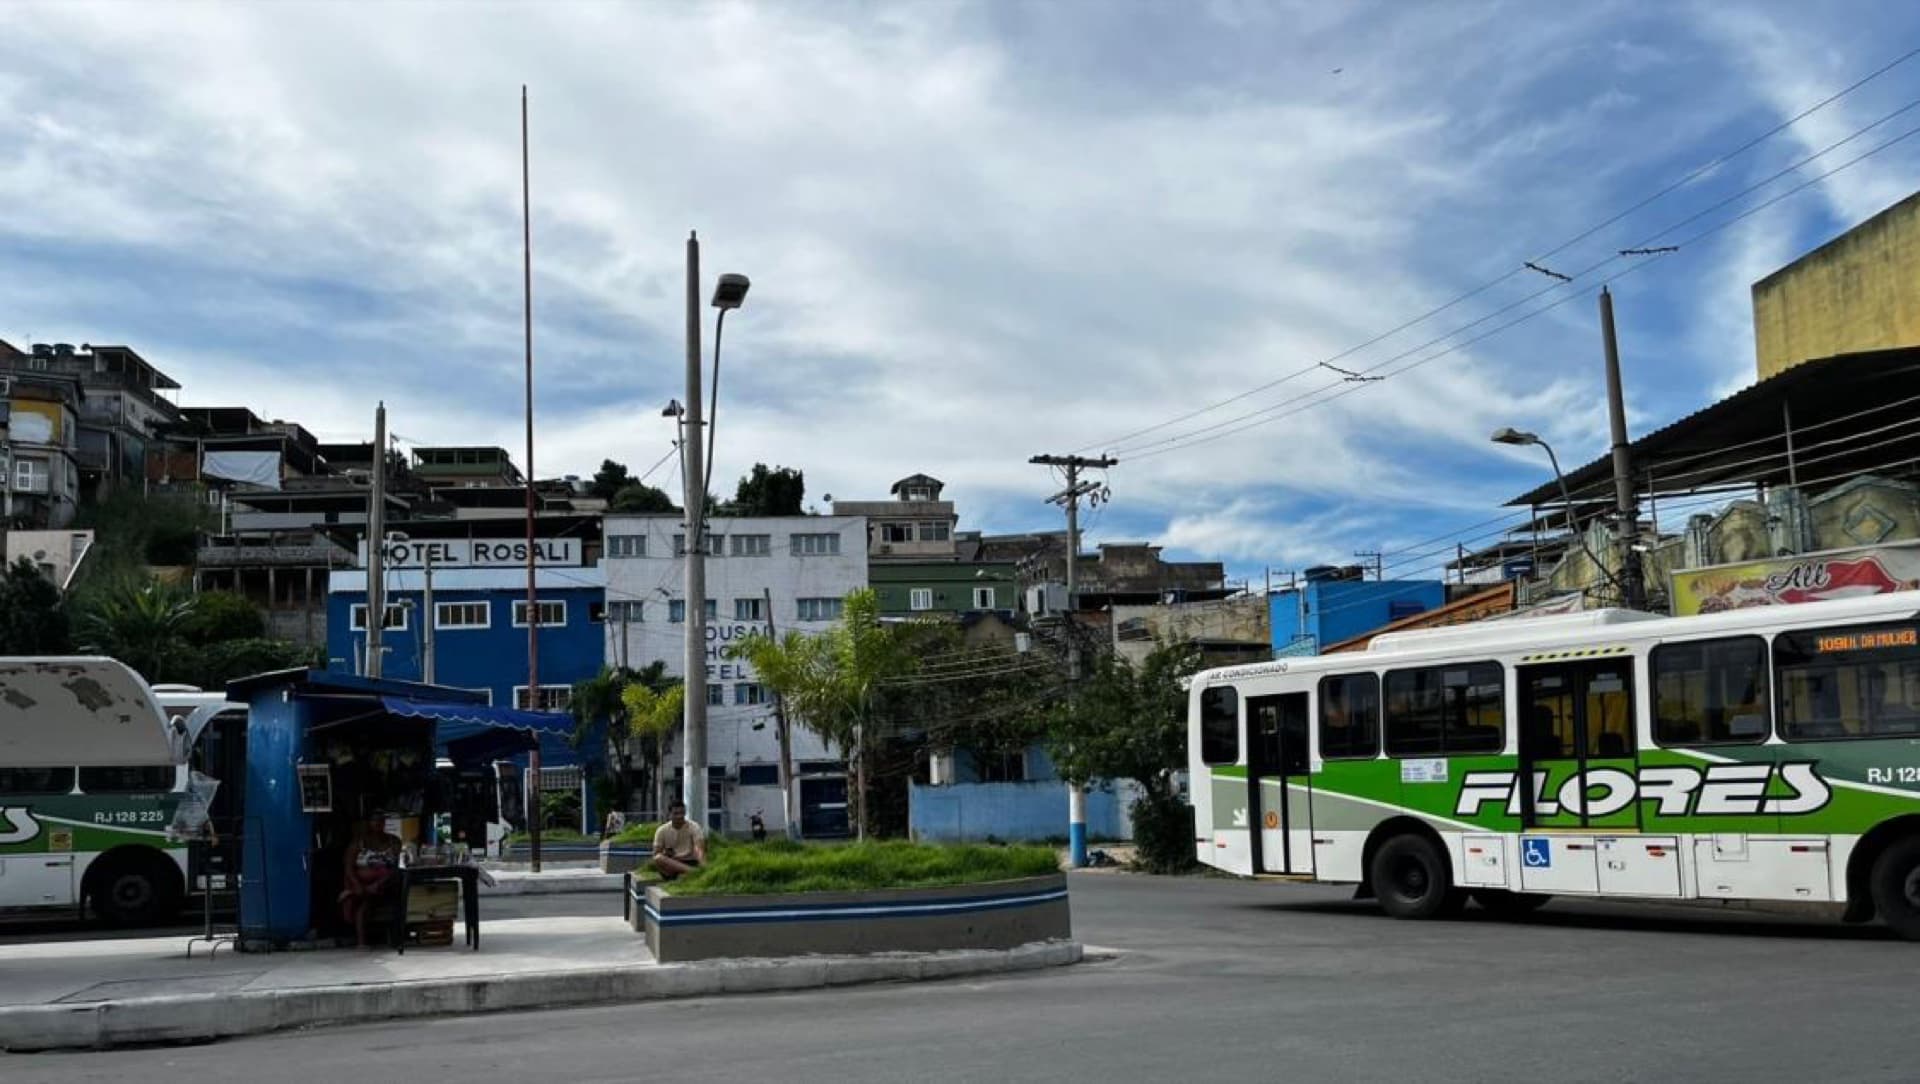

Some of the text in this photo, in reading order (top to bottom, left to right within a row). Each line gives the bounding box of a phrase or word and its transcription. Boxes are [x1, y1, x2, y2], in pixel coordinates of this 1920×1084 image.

[474, 542, 569, 562] ROSALI
[1876, 629, 1918, 648] MULHER
[1868, 767, 1892, 783] RJ
[1454, 763, 1831, 817] FLORES
[95, 810, 164, 823] RJ 128 225
